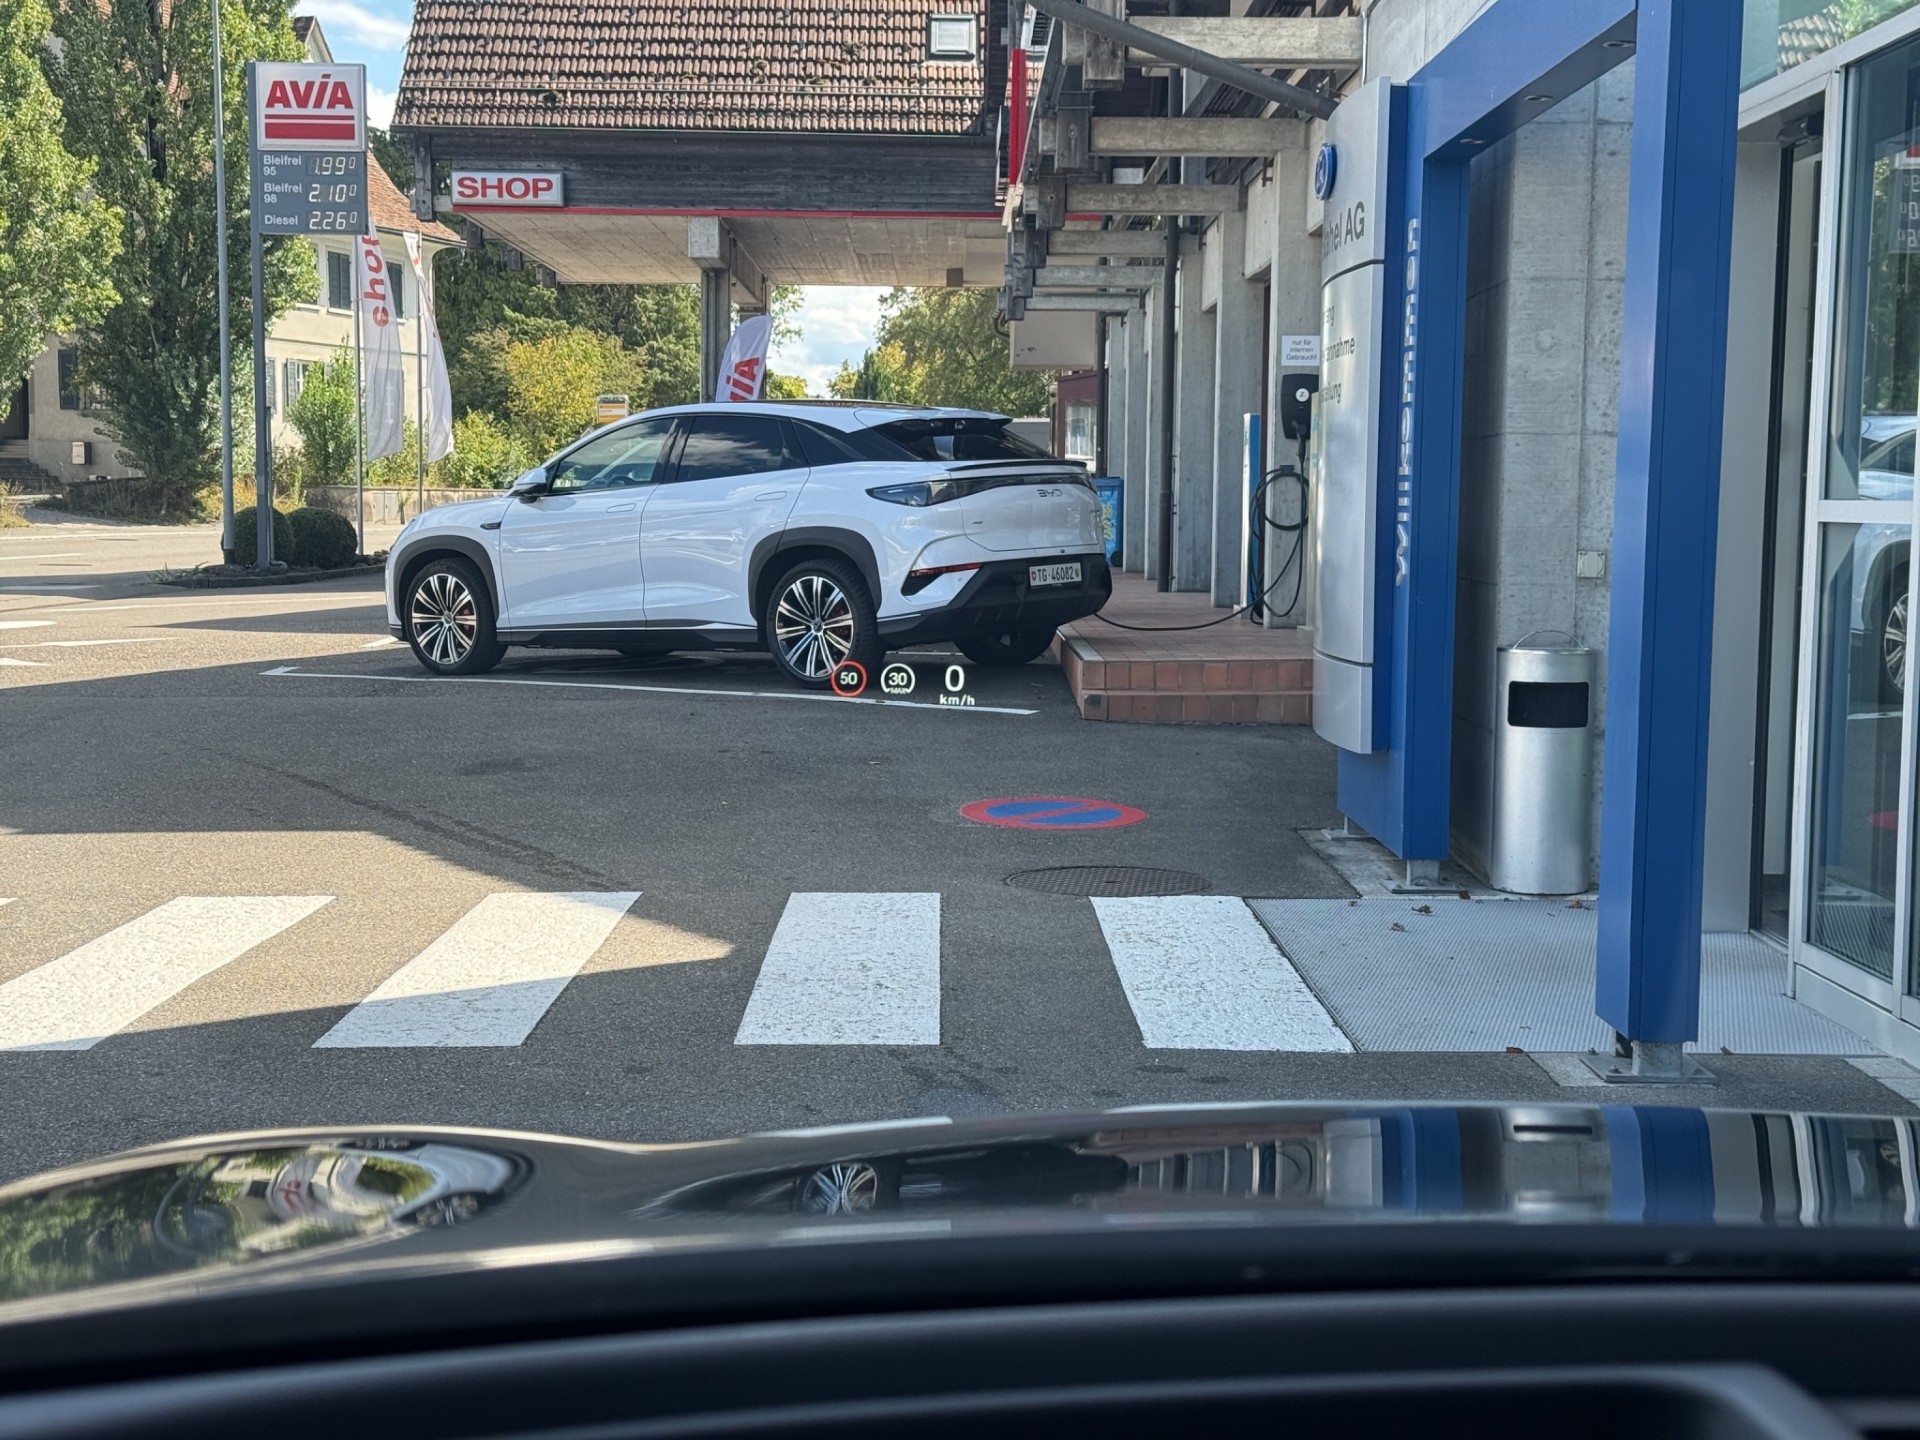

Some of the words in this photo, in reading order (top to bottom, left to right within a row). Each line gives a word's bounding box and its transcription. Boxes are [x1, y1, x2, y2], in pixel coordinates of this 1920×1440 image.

[265, 73, 354, 109] AVIA
[263, 155, 302, 167] Bleifrei
[263, 167, 276, 176] 95
[263, 183, 302, 195] Bleifrei
[456, 176, 554, 200] SHOP
[263, 195, 277, 204] 98
[264, 215, 298, 226] Diesel
[1344, 200, 1365, 246] AG
[1303, 338, 1312, 346] für
[840, 672, 858, 685] 50
[888, 672, 908, 686] 30
[945, 665, 965, 692] 0
[939, 694, 975, 706] km/h
